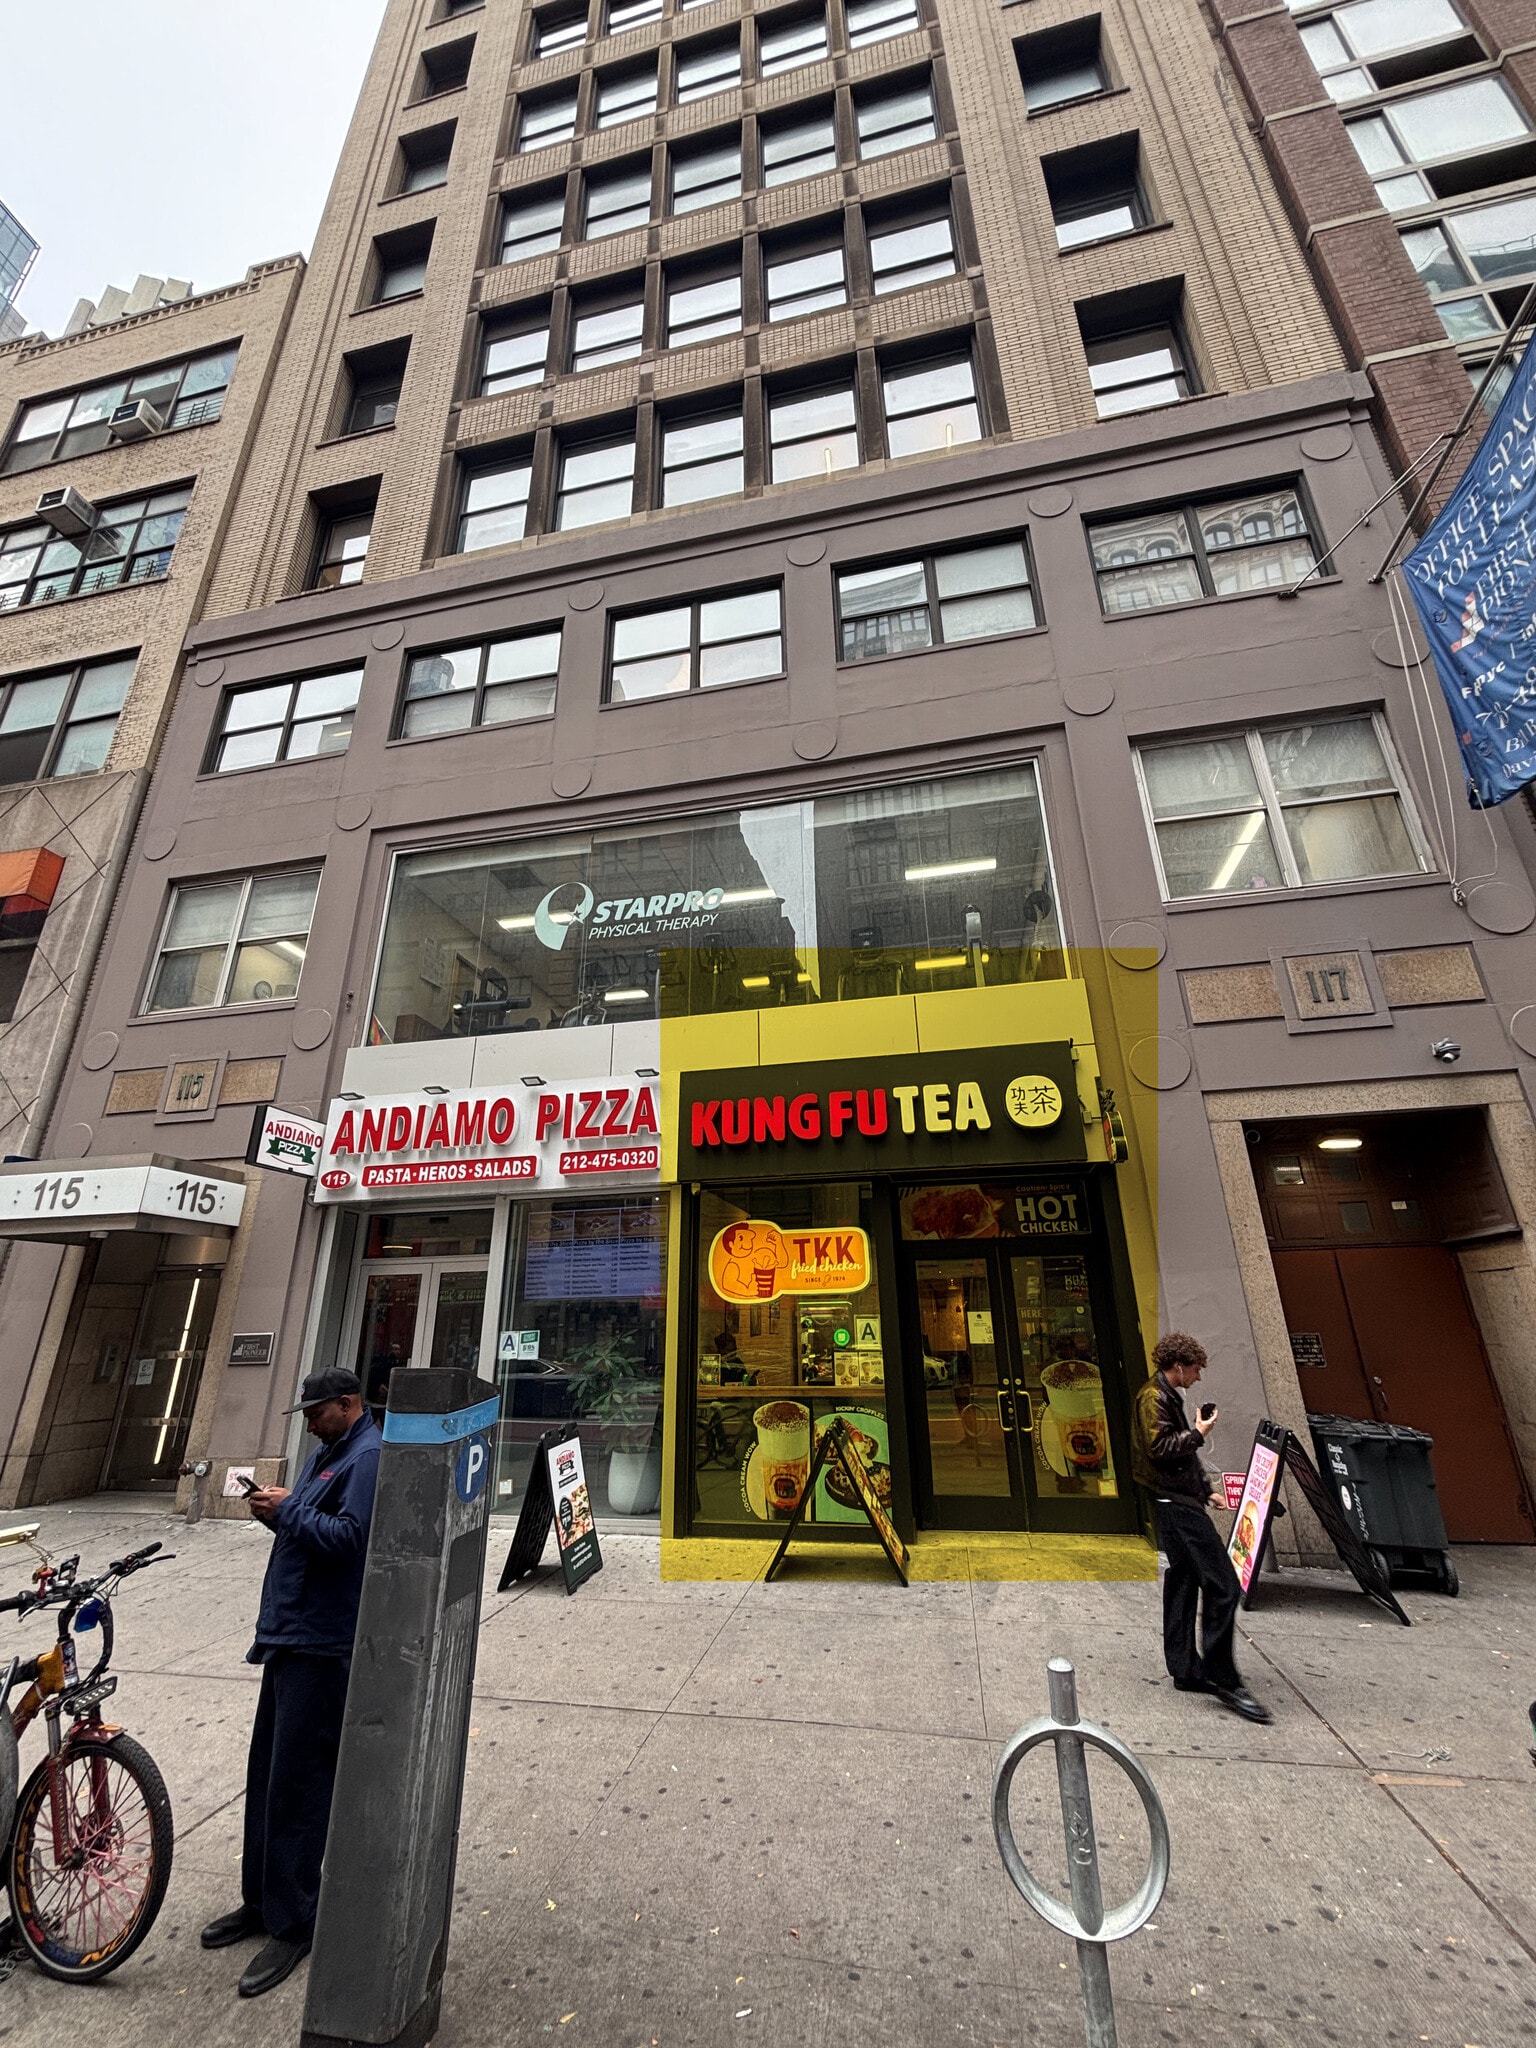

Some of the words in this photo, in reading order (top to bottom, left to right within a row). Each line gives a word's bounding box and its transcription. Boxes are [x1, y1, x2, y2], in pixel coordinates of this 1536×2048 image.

[1414, 482, 1486, 583] OFFICE
[1487, 373, 1536, 488] SPAC
[1475, 511, 1530, 599] FIRST
[1438, 540, 1478, 600] FOR
[592, 887, 725, 924] STARPRO
[588, 921, 652, 940] PHYSICAL
[655, 913, 719, 932] THERAPY
[1306, 967, 1350, 1003] 117
[176, 1073, 205, 1100] 115
[330, 1097, 515, 1156] ANDIAMO
[536, 1086, 658, 1141] PIZZA
[690, 1093, 821, 1147] KUNG
[829, 1088, 888, 1138] FU
[892, 1081, 992, 1135] TEA
[265, 1121, 323, 1148] ANDIAMO
[277, 1141, 306, 1156] PIZZA
[563, 1150, 655, 1170] 212-475-0320
[325, 1173, 347, 1186] 115
[368, 1168, 411, 1185] PASTA
[418, 1164, 467, 1181] HEROS
[473, 1159, 532, 1178] SALADS
[34, 1177, 84, 1211] 115
[175, 1179, 218, 1214] 115
[1015, 1194, 1077, 1222] HOT
[1020, 1221, 1079, 1234] CHICKEN
[792, 1235, 856, 1268] TKK
[790, 1257, 817, 1280] fried
[818, 1255, 863, 1273] chicken
[1020, 1309, 1043, 1319] HERE
[502, 1334, 515, 1351] A
[861, 1322, 876, 1341] A
[465, 1444, 484, 1494] P
[1225, 1475, 1245, 1485] SPRIN
